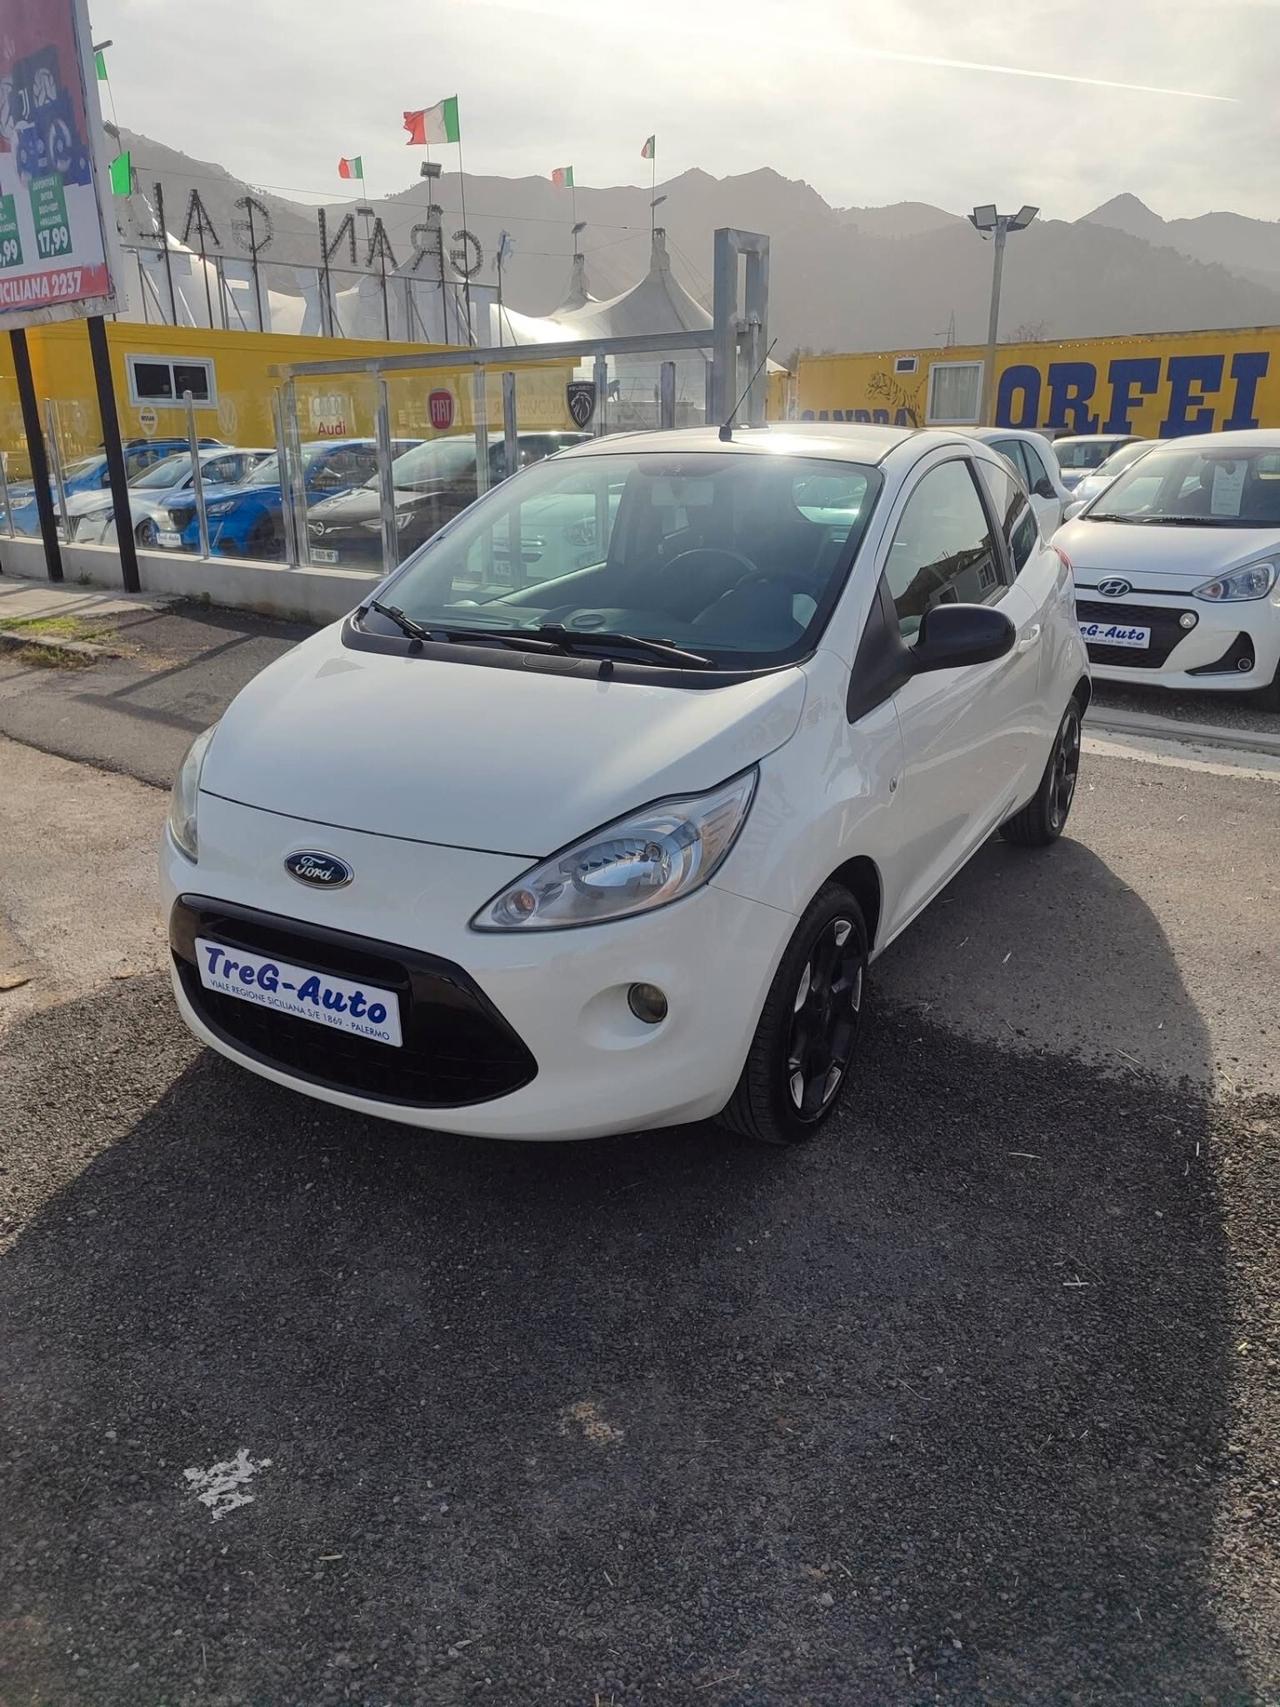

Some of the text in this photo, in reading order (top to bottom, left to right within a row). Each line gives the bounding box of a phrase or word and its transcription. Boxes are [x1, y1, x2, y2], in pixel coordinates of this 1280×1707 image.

[0, 239, 18, 267] ,99
[38, 226, 68, 255] 17,99
[0, 271, 82, 303] ICILIANA 2237
[995, 352, 1270, 439] ORFEI
[431, 399, 451, 422] FIAT
[318, 421, 346, 435] Audi
[1080, 625, 1145, 640] eG-Auto
[295, 855, 335, 881] Ford
[205, 947, 387, 1023] TreG-Auto
[210, 980, 229, 992] VIALE
[231, 985, 265, 1003] REGIONE
[267, 996, 306, 1015] SICILIANA
[308, 1008, 320, 1020] S/E
[324, 1013, 343, 1026] 1869
[351, 1022, 390, 1041] PALERMO
